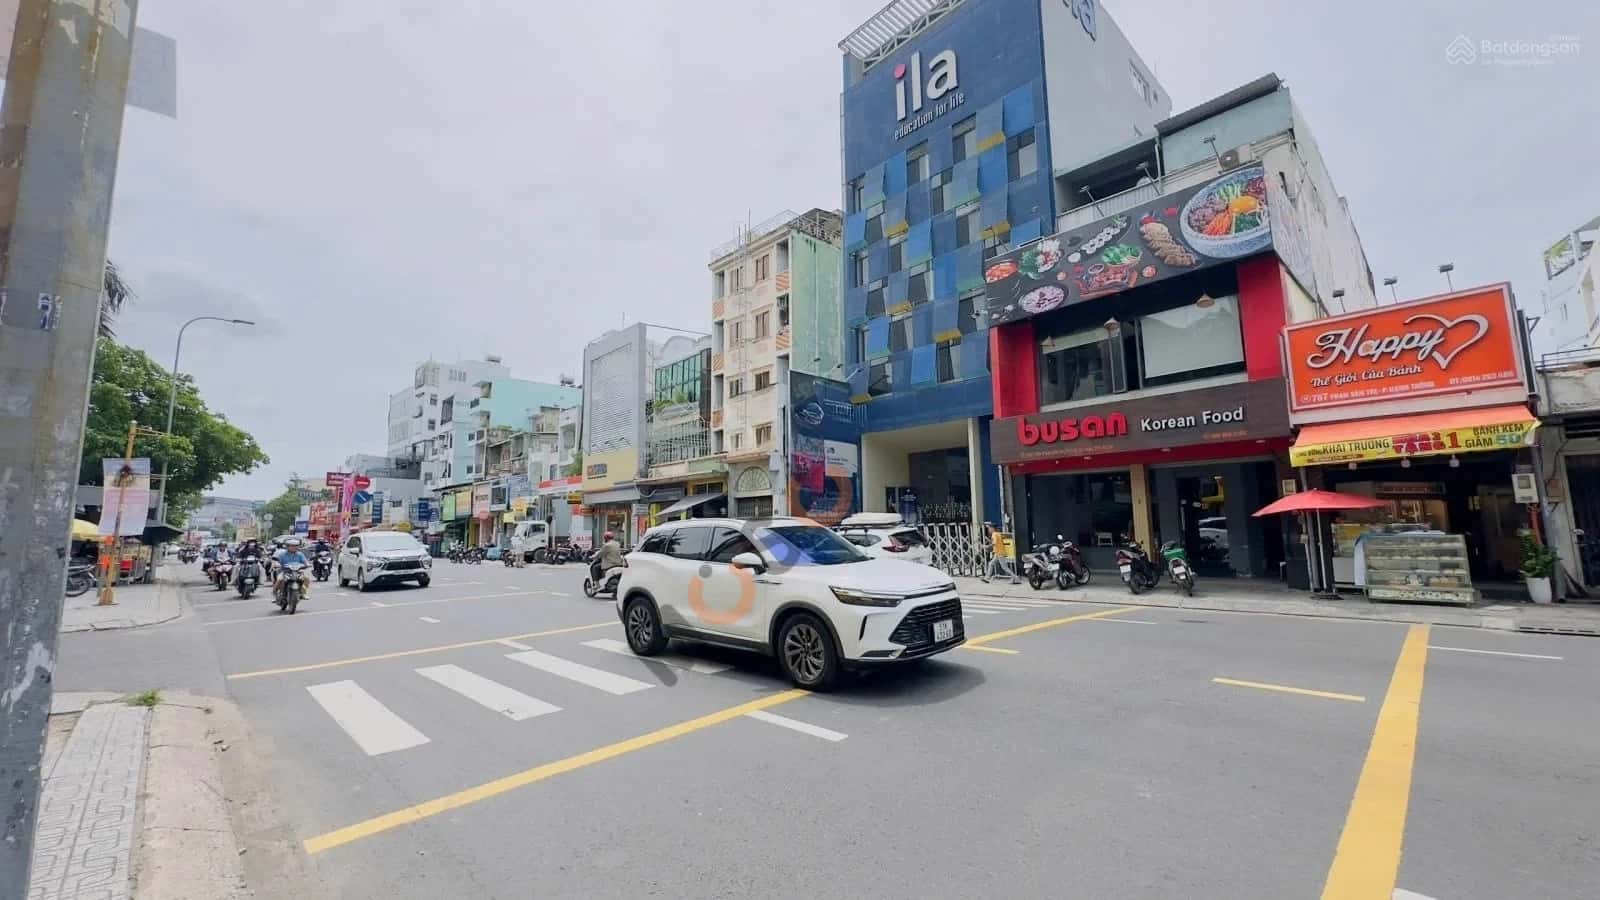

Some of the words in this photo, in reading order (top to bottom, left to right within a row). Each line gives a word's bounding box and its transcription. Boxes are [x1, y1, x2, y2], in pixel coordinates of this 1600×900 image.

[894, 49, 958, 121] ila
[894, 111, 933, 140] education
[936, 102, 947, 118] for
[950, 92, 966, 109] life
[1306, 323, 1446, 369] Happy
[1389, 364, 1422, 377] Bánh
[1017, 411, 1128, 446] busan
[1141, 415, 1196, 431] Korean
[1202, 406, 1244, 425] Food
